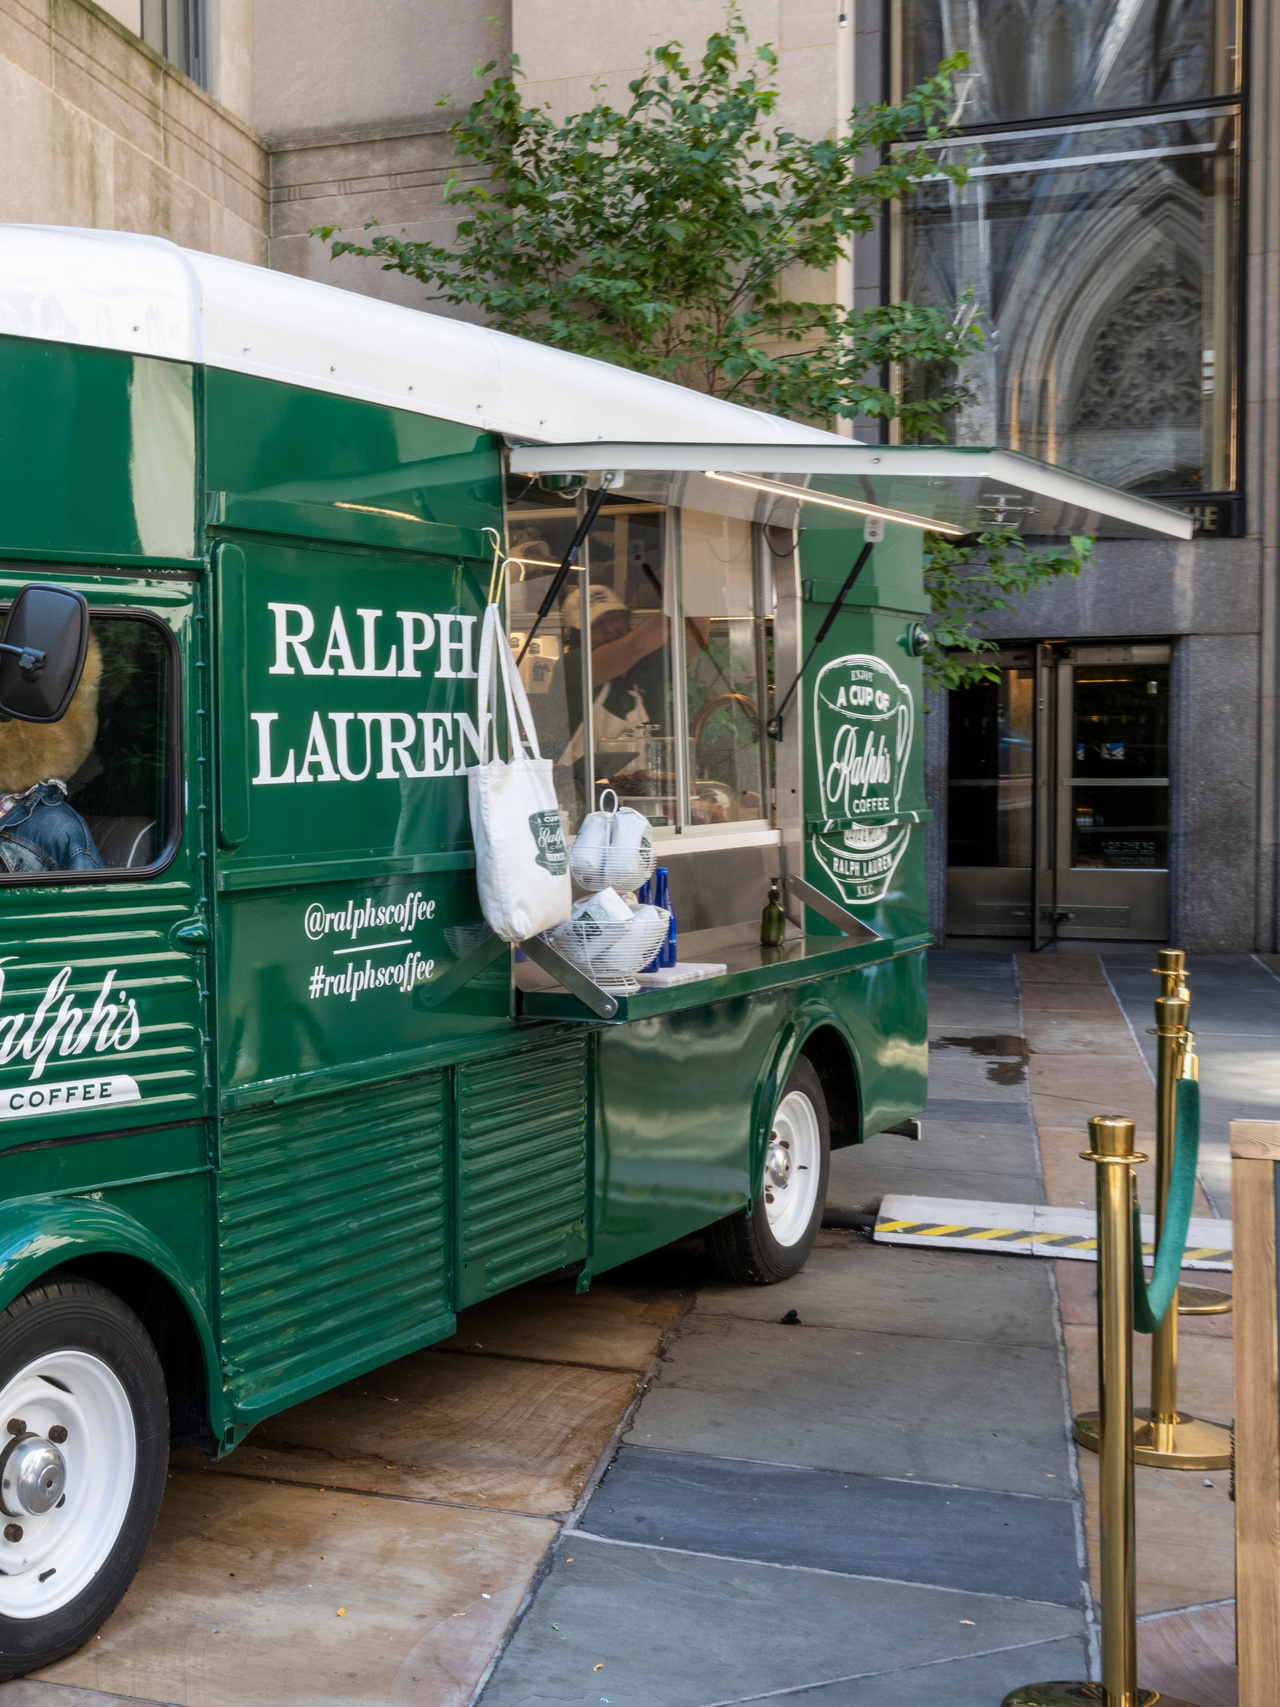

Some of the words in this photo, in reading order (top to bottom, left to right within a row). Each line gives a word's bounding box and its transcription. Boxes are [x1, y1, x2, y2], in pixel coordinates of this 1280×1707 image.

[267, 602, 478, 679] RALPH
[836, 686, 847, 707] A
[849, 685, 874, 706] CUP
[875, 689, 890, 712] OF
[250, 711, 492, 785] LAUREN
[826, 724, 891, 803] Ralph's
[852, 797, 890, 814] COFFEE
[833, 857, 860, 877] RALPH
[863, 853, 893, 877] LAUREN
[304, 891, 436, 941] @ralphscoffee
[308, 951, 435, 1002] #ralphscoffee
[9, 1081, 113, 1111] COFFEE
